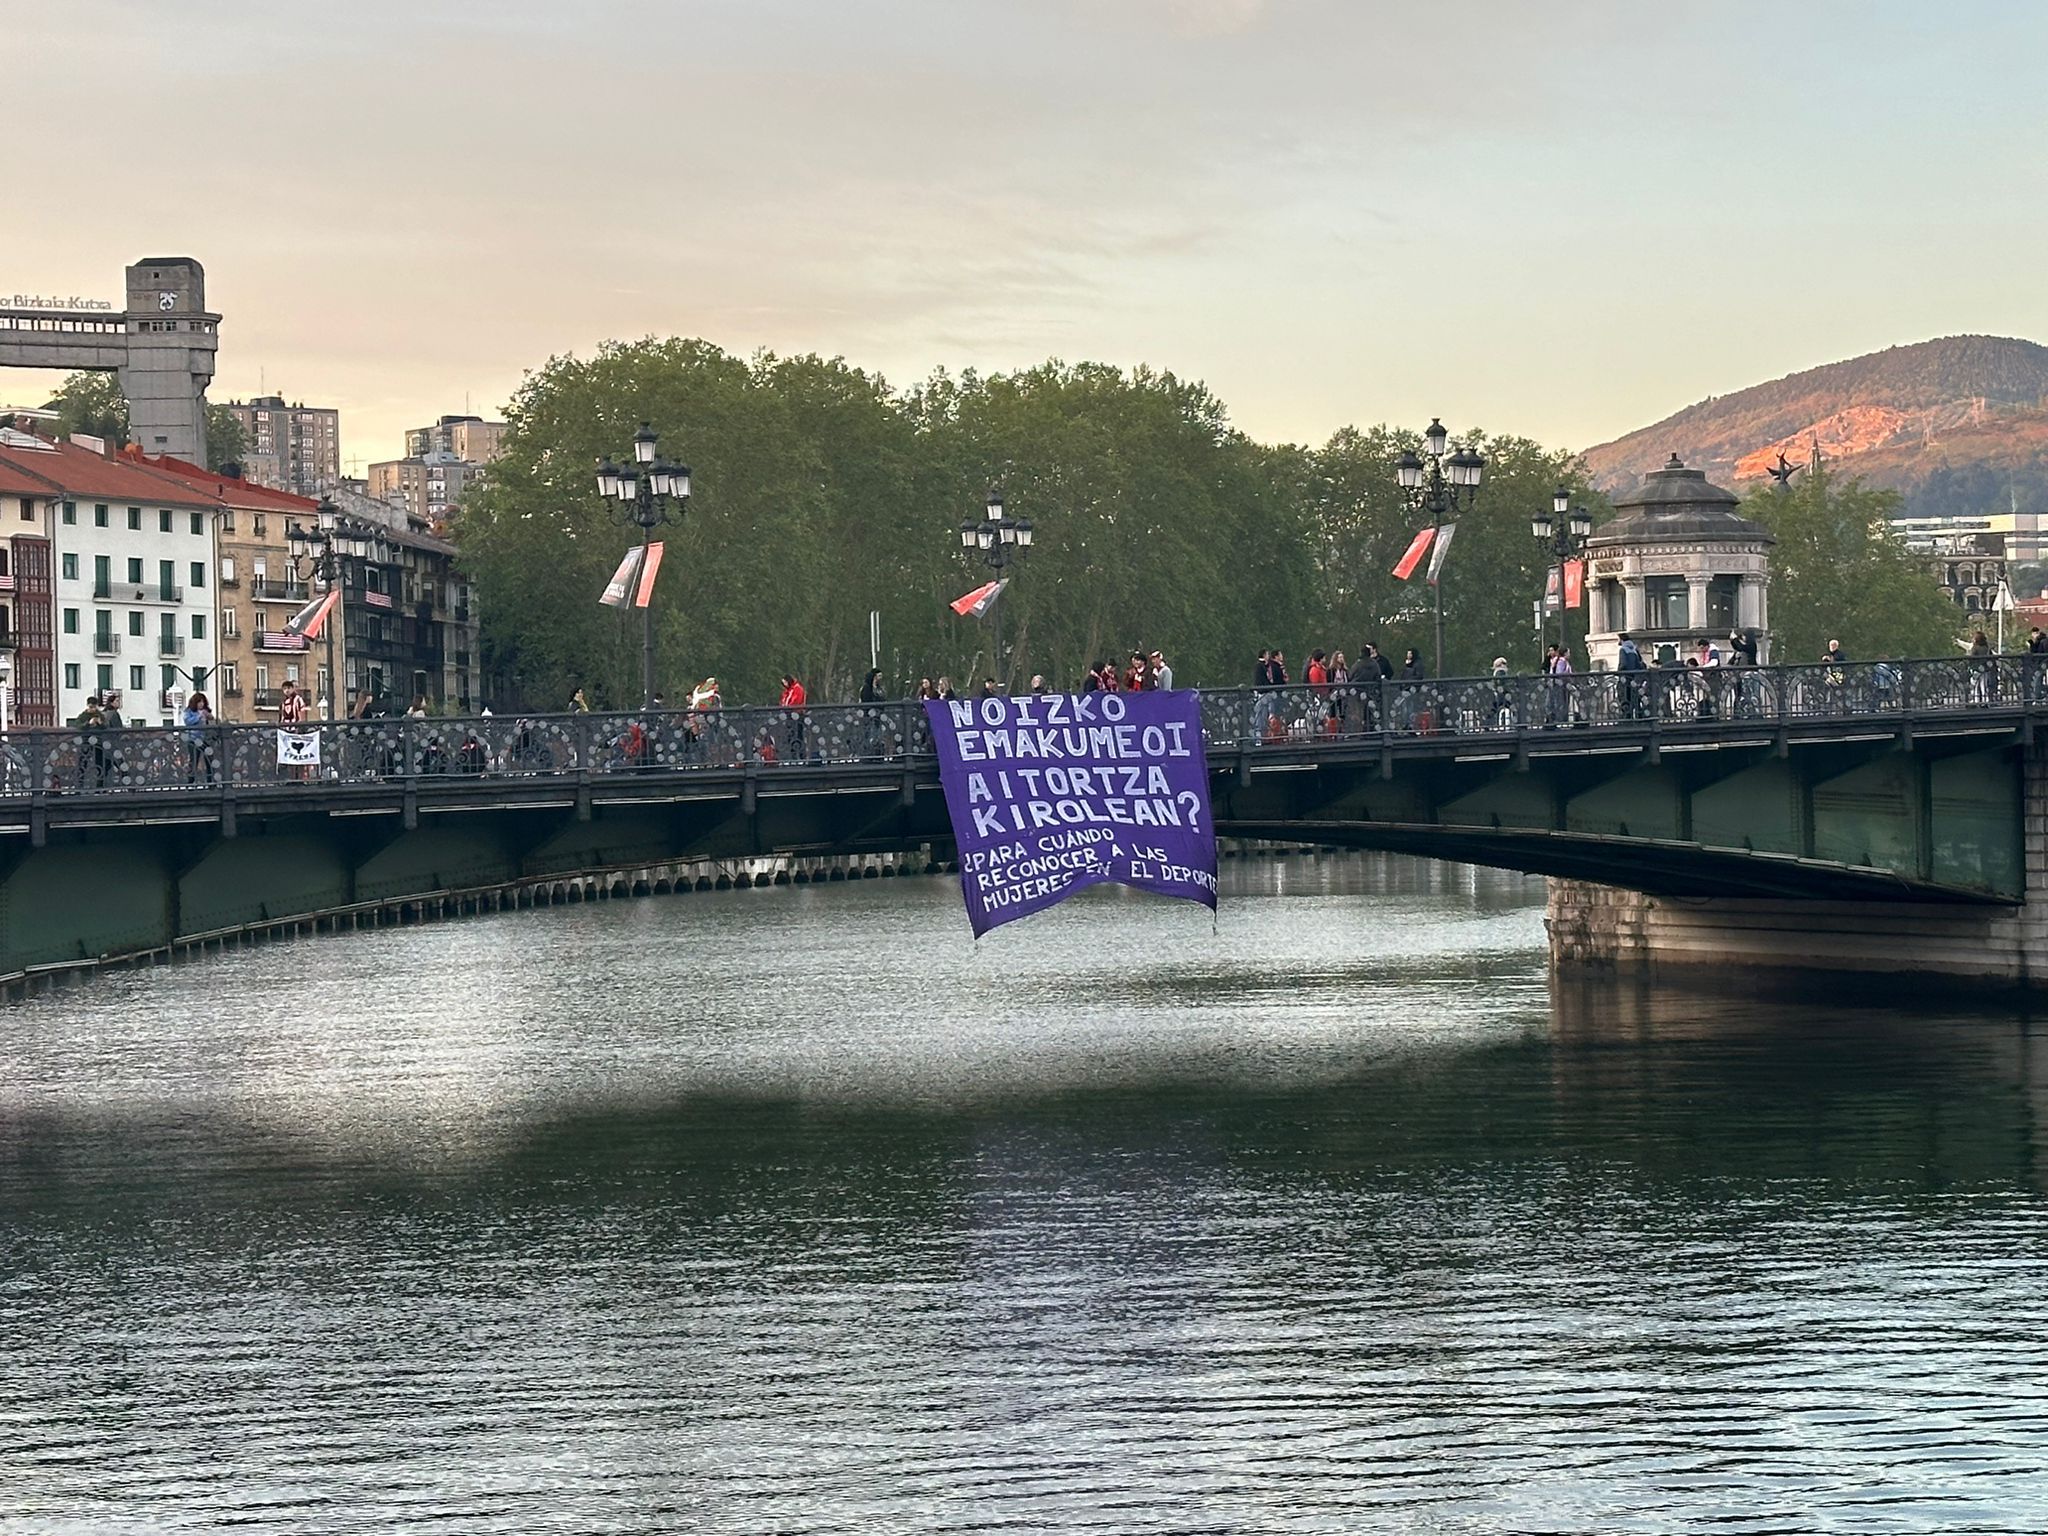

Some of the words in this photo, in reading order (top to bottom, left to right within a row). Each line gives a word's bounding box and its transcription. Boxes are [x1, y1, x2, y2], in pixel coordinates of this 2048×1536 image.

[13, 294, 65, 308] Bizkaia
[69, 296, 112, 310] Kutxa
[948, 694, 1126, 728] NOIZKO
[956, 722, 1190, 761] EMAKUMEOI
[968, 766, 1171, 803] AITORTZA
[971, 791, 1200, 837] KIROLEAN?
[964, 841, 1028, 873] ¿PARA
[1038, 828, 1114, 852] CUÁNDO
[977, 848, 1099, 892] RECONOCER
[1111, 843, 1125, 857] A
[1131, 843, 1168, 862] LAS
[982, 871, 1075, 913] MUJERES
[1131, 860, 1154, 878] EL
